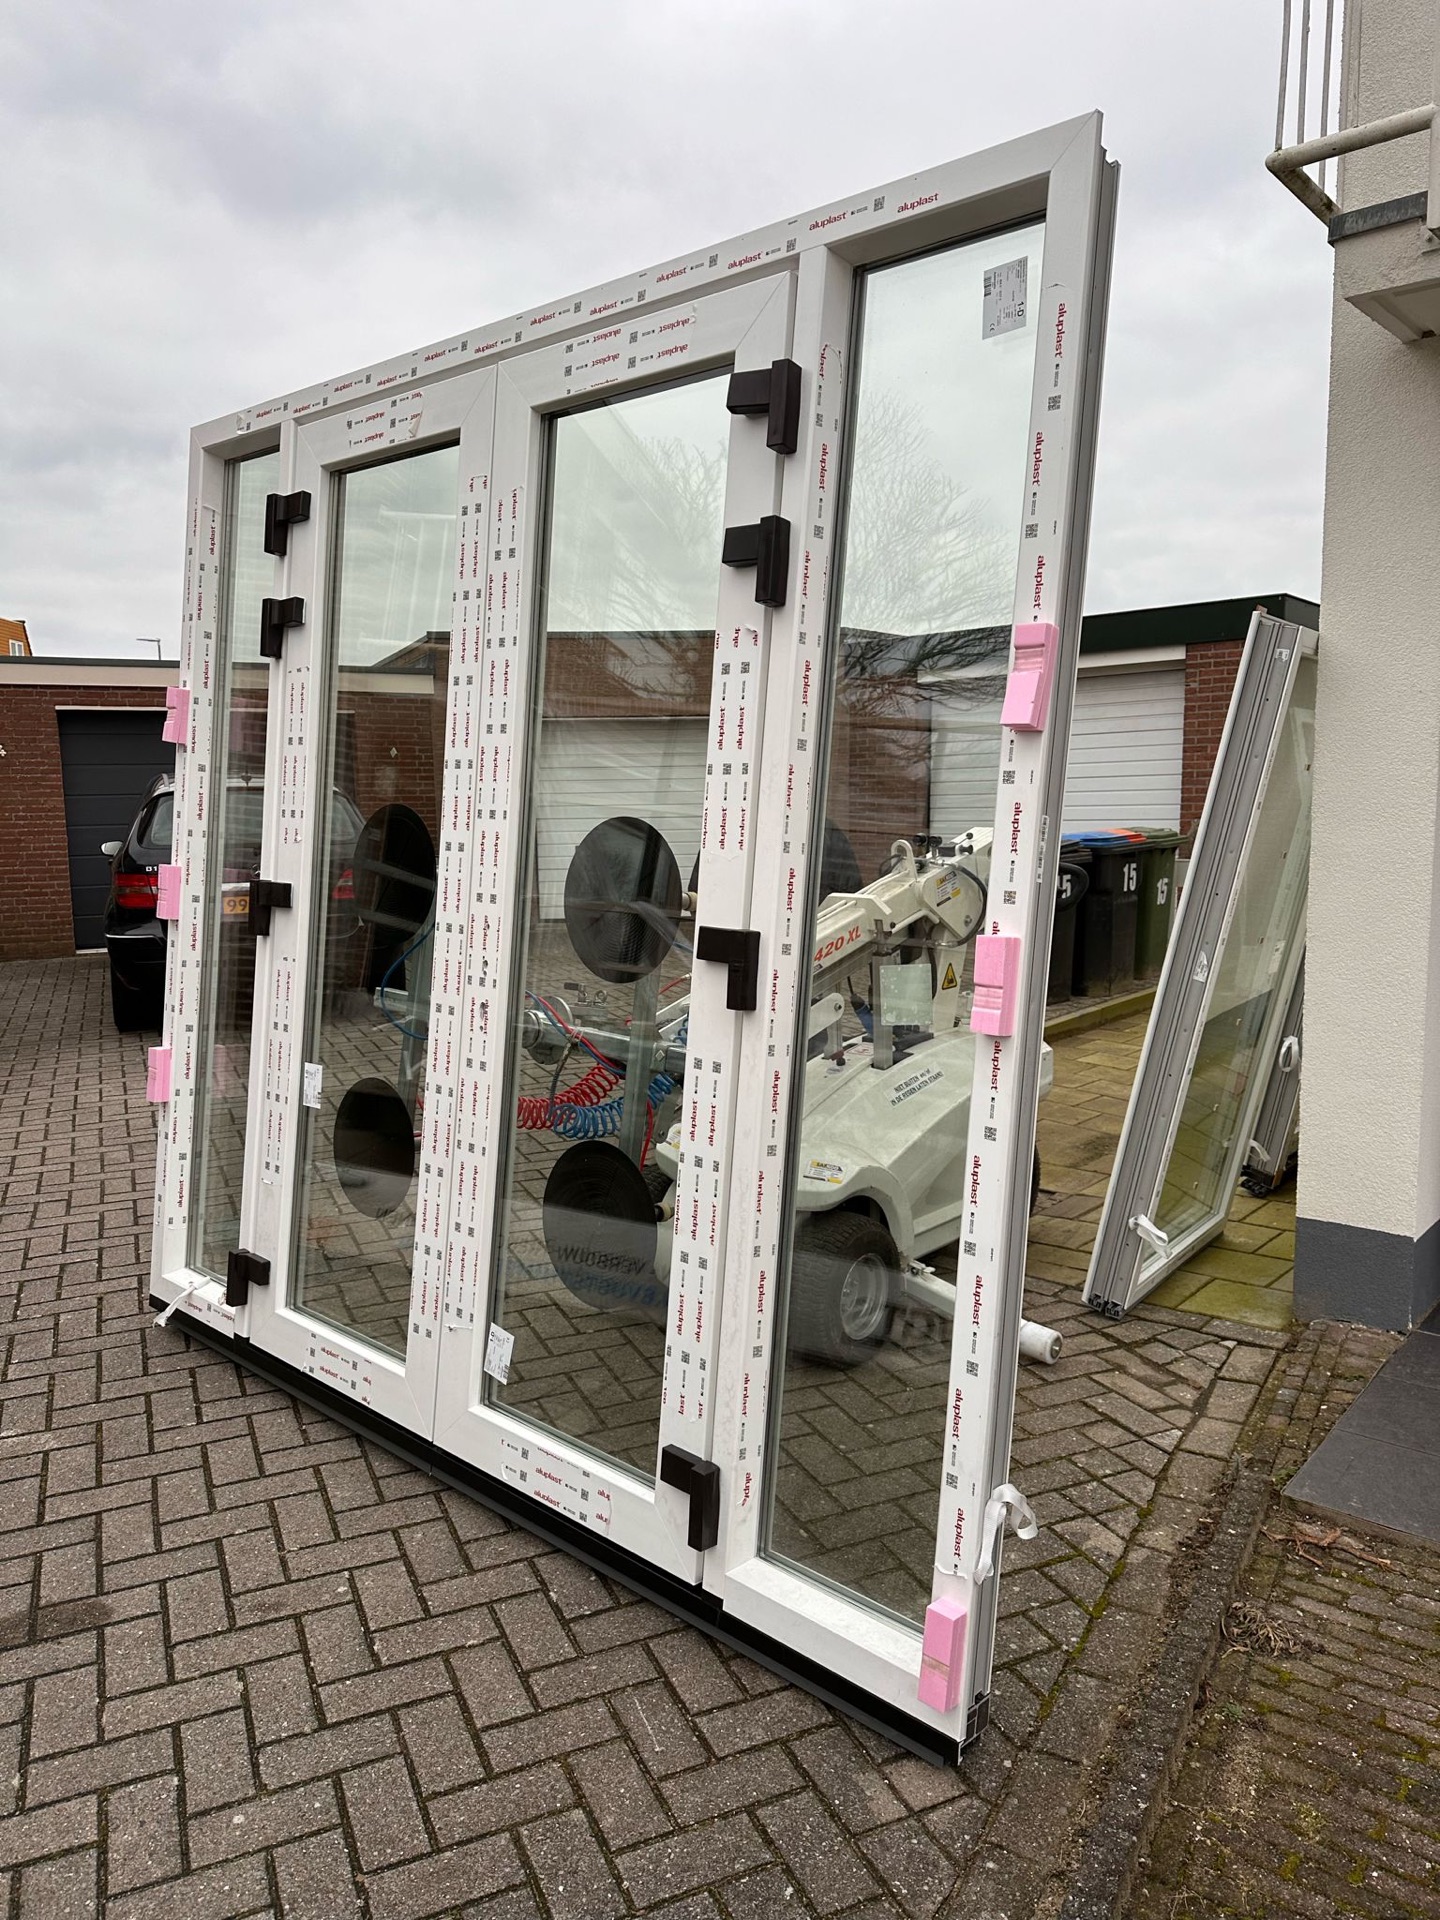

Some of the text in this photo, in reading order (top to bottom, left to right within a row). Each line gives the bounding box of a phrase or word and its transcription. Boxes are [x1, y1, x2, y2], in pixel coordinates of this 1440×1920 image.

[809, 210, 848, 231] aluplast
[897, 193, 939, 212] aluplast
[656, 268, 687, 282] aluplast
[727, 251, 763, 269] aluplast
[530, 313, 556, 325] aluplast
[589, 300, 619, 316] aluplast
[659, 318, 690, 333] aluplast
[1016, 301, 1025, 317] 1-D
[474, 341, 498, 354] aluplast
[593, 328, 622, 343] aluplast
[1055, 302, 1067, 359] aluplast
[424, 349, 446, 362] aluplast
[591, 353, 620, 366] aluplast
[656, 345, 688, 360] aluplast
[335, 382, 354, 392] aluplast
[377, 375, 397, 386] aluplast
[256, 409, 272, 418] aluplast
[293, 404, 311, 414] aluplast
[365, 411, 385, 422] aluplast
[363, 432, 384, 443] aluplast
[818, 443, 829, 493] aluplast
[1032, 431, 1045, 487] aluplast
[802, 550, 811, 599] aluplast
[1033, 555, 1046, 610] aluplast
[202, 659, 210, 690] aluplast
[802, 659, 812, 708] aluplast
[717, 705, 727, 751] aluplast
[736, 706, 745, 750] aluplast
[786, 763, 795, 810] aluplast
[196, 791, 204, 821] aluplast
[719, 806, 728, 850] aluplast
[738, 806, 746, 851] aluplast
[1010, 801, 1023, 856] aluplast
[786, 867, 796, 912] aluplast
[1123, 863, 1138, 892] 15
[1156, 877, 1169, 905] 15
[814, 925, 862, 962] 420 XL
[770, 968, 780, 1015] aluplast
[990, 1040, 1003, 1092] aluplast
[471, 1080, 479, 1118] aluplast
[771, 1070, 781, 1115] aluplast
[689, 1097, 698, 1142] aluplast
[707, 1102, 717, 1147] aluplast
[444, 1121, 452, 1158] aluplast
[458, 1161, 466, 1198] aluplast
[471, 1165, 479, 1200] aluplast
[755, 1170, 765, 1215] aluplast
[970, 1154, 982, 1208] aluplast
[690, 1198, 699, 1241] aluplast
[709, 1201, 717, 1247] aluplast
[420, 1280, 428, 1316] aluplast
[757, 1270, 767, 1315] aluplast
[972, 1274, 984, 1327] aluplast
[676, 1293, 685, 1336] aluplast
[694, 1299, 703, 1343] aluplast
[320, 1346, 340, 1359] aluplast
[319, 1365, 339, 1379] aluplast
[741, 1373, 751, 1418] aluplast
[952, 1388, 964, 1440] aluplast
[535, 1467, 563, 1485] aluplast
[533, 1490, 561, 1507] aluplast
[953, 1507, 966, 1561] aluplast
